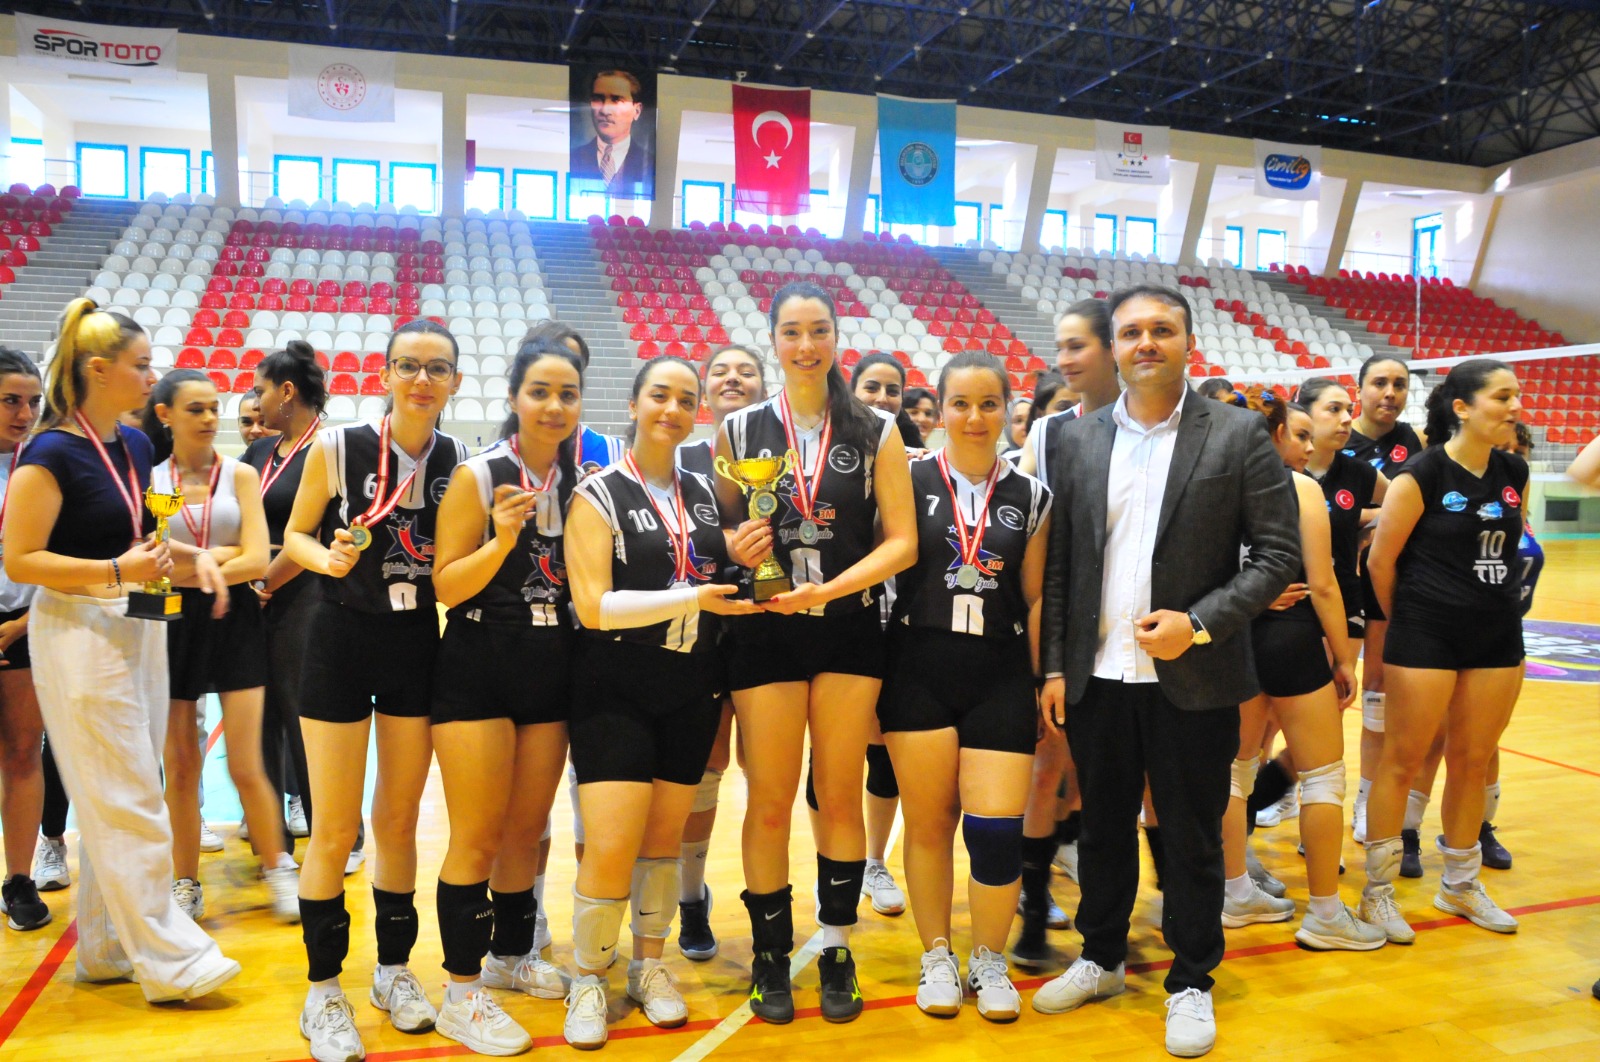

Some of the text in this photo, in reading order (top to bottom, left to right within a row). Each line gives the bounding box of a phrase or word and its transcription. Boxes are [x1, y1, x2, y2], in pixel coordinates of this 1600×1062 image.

[363, 473, 379, 499] 6
[819, 508, 836, 519] 3M
[926, 494, 940, 517] 7
[627, 508, 658, 533] 10
[1479, 530, 1507, 559] 10
[702, 563, 717, 574] 3M
[986, 560, 1005, 571] 3M
[1472, 564, 1508, 585] TIP
[1521, 556, 1534, 580] 7
